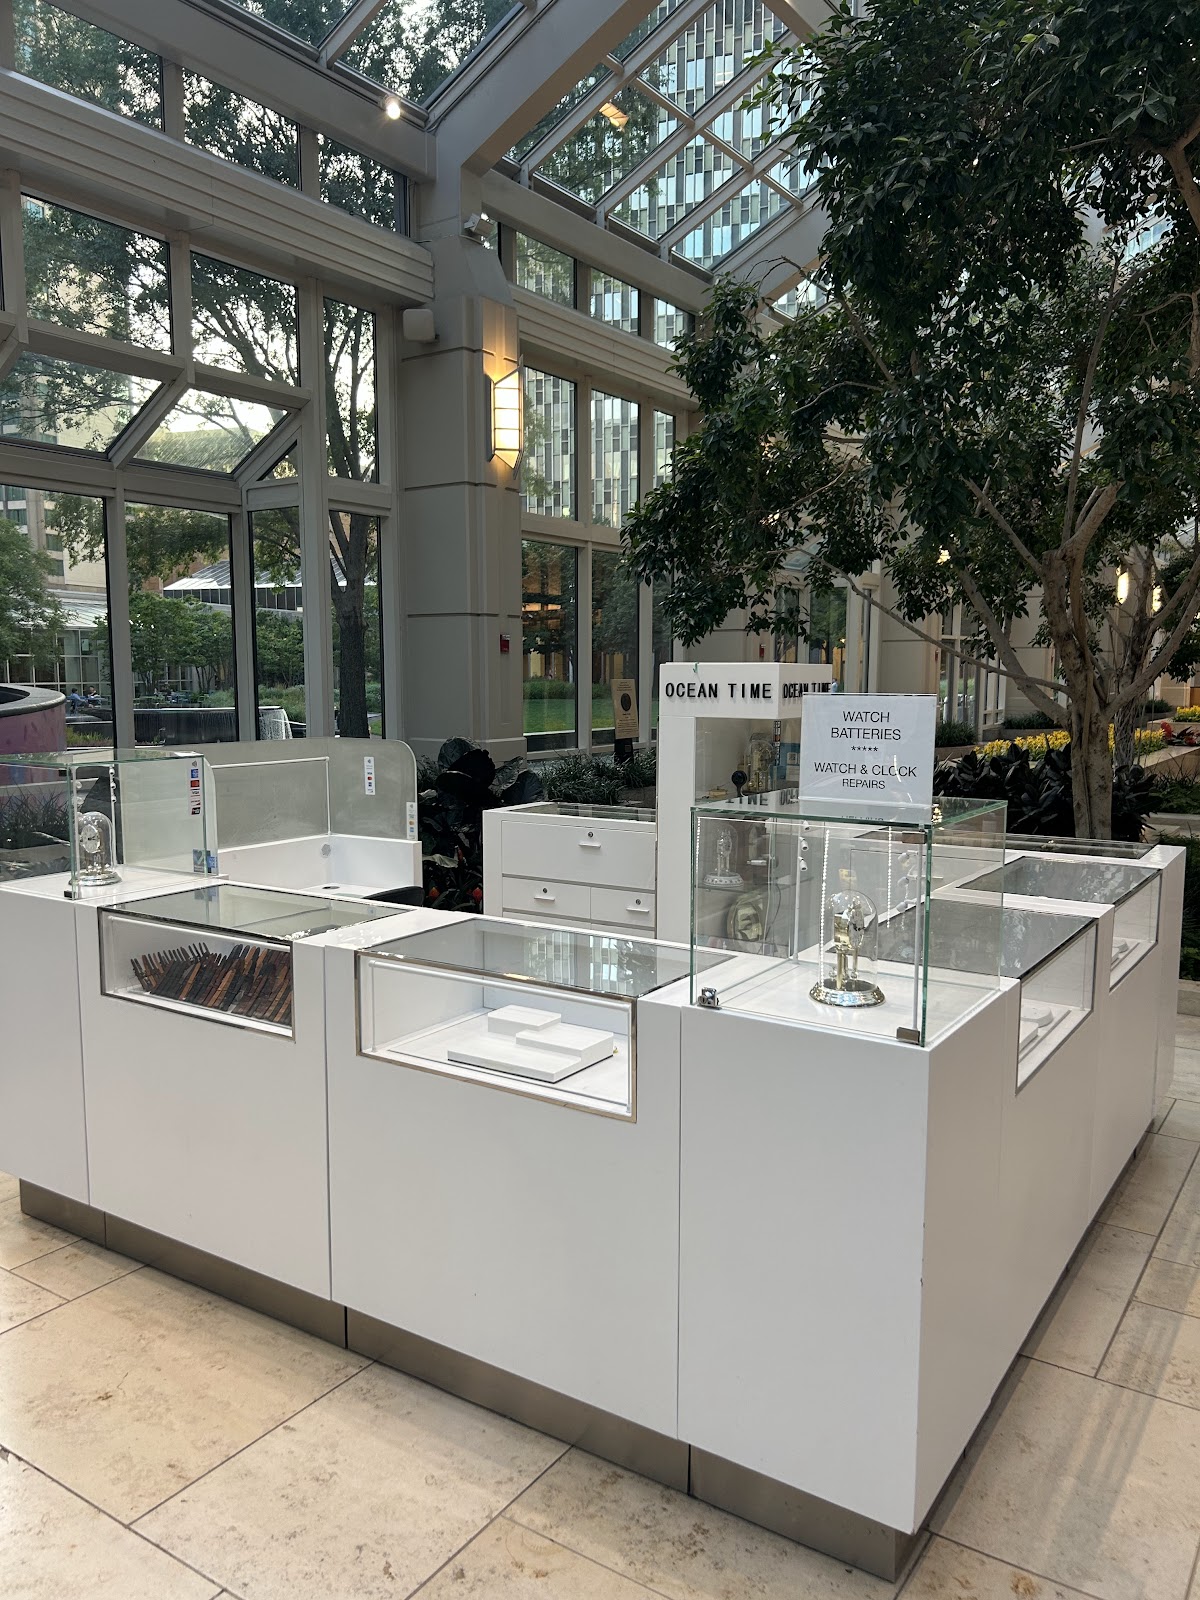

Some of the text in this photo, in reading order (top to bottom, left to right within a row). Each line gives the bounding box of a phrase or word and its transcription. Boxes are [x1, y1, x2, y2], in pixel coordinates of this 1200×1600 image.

[665, 682, 772, 699] OCEAN TIME
[843, 711, 890, 723] WATCH
[831, 727, 902, 741] BATTERIES
[814, 762, 918, 778] WATCH & CLOCK
[842, 778, 886, 789] REPAIRS
